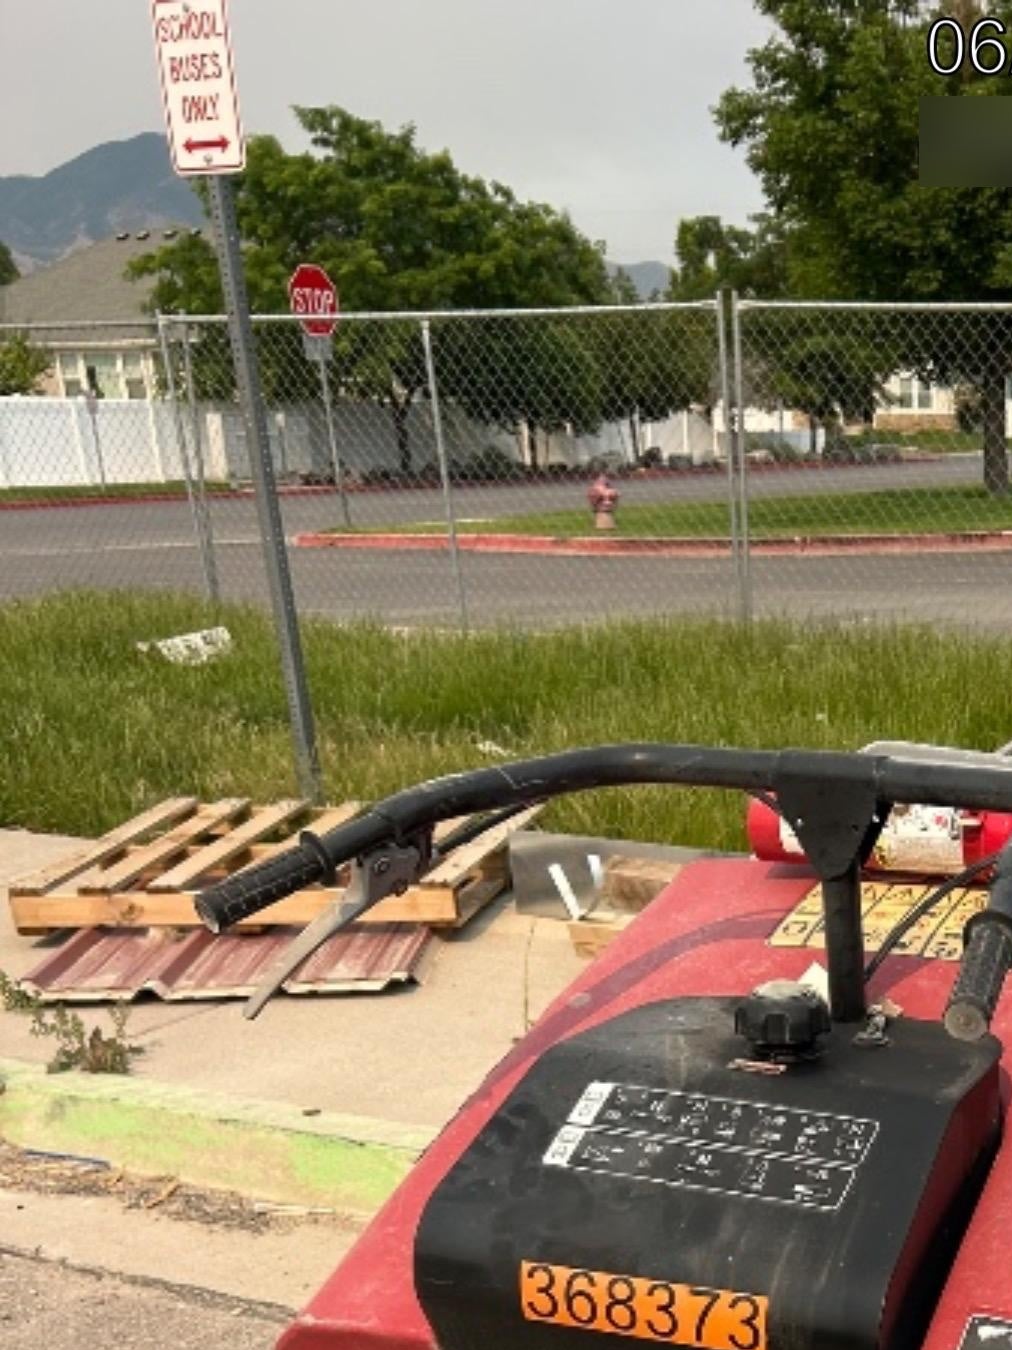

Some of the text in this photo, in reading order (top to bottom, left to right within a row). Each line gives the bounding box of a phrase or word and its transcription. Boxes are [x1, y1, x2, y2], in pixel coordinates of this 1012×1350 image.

[158, 11, 223, 42] SCHOOL
[169, 51, 222, 83] BUSES
[181, 93, 220, 123] ONLY
[293, 287, 334, 314] STOP
[526, 1265, 761, 1350] 368373
